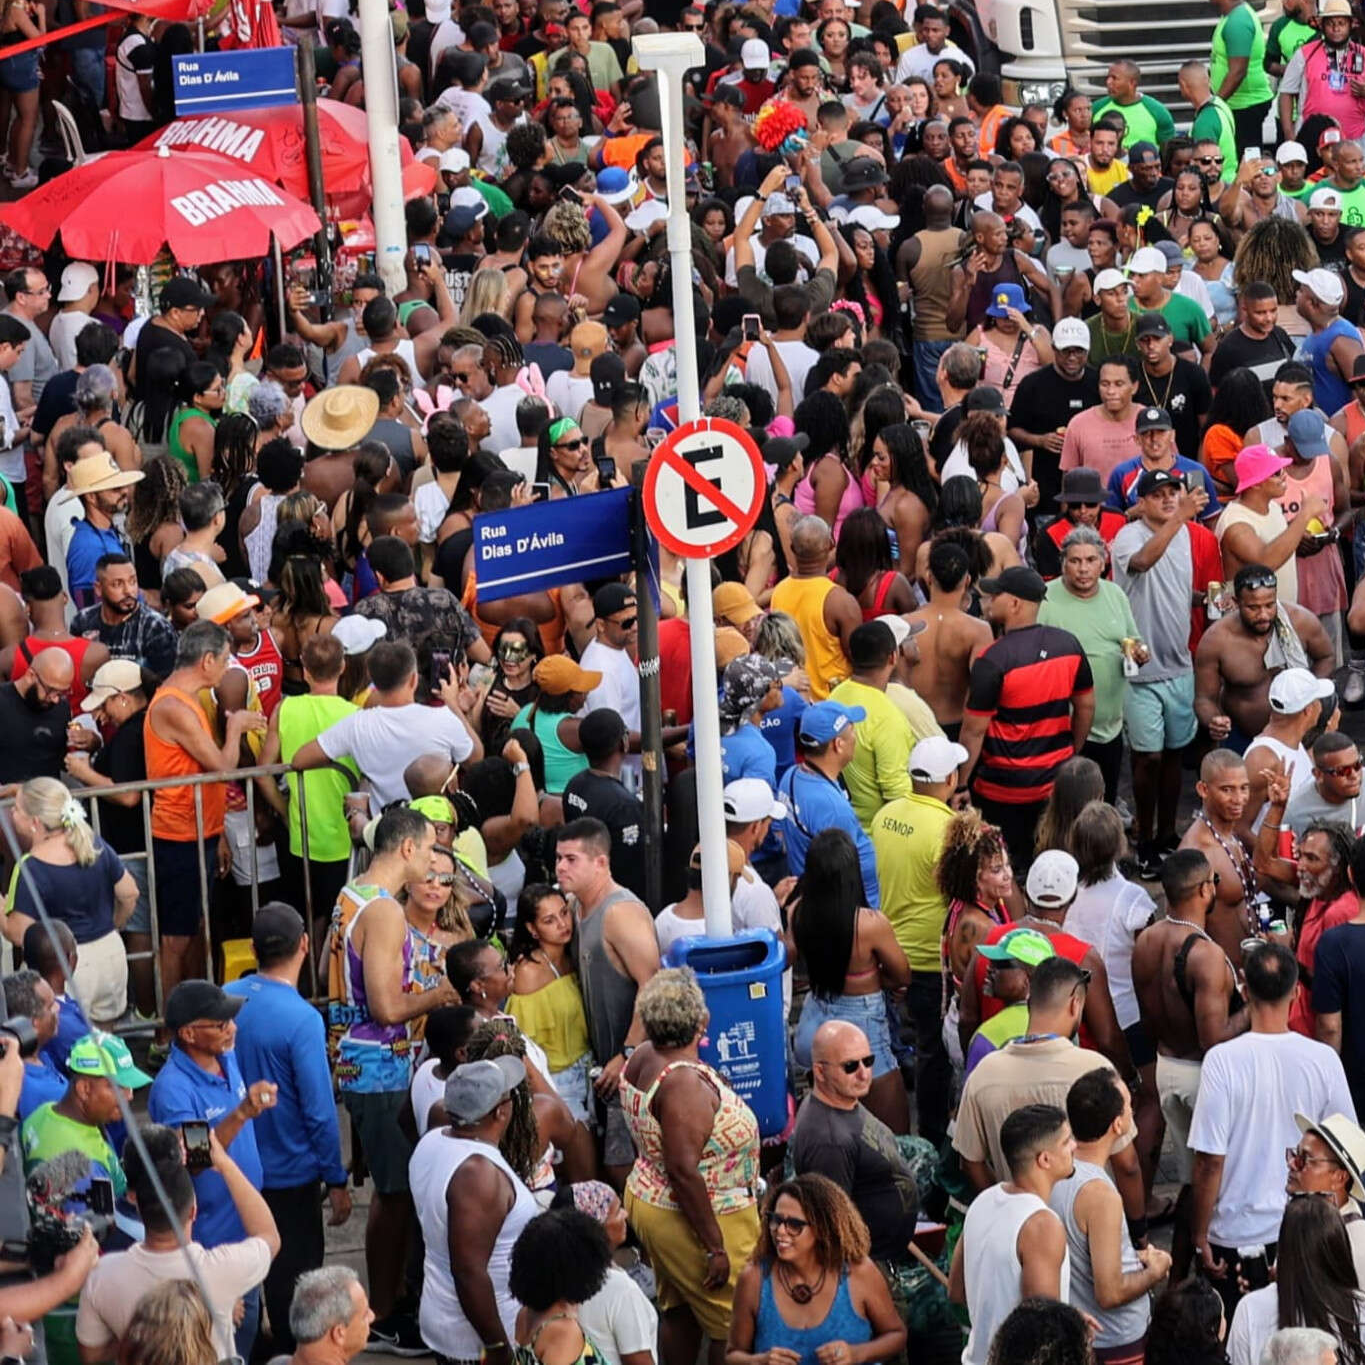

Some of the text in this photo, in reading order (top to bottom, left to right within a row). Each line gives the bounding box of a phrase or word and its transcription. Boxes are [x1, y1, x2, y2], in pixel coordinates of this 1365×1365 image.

[179, 62, 199, 73] Rua
[179, 74, 202, 86] Dias
[159, 115, 266, 163] BRAHMA
[169, 179, 286, 227] BRAHMA
[481, 524, 507, 541] Rua
[482, 531, 565, 561] Dias D'Ávila
[883, 816, 915, 839] SEMOP
